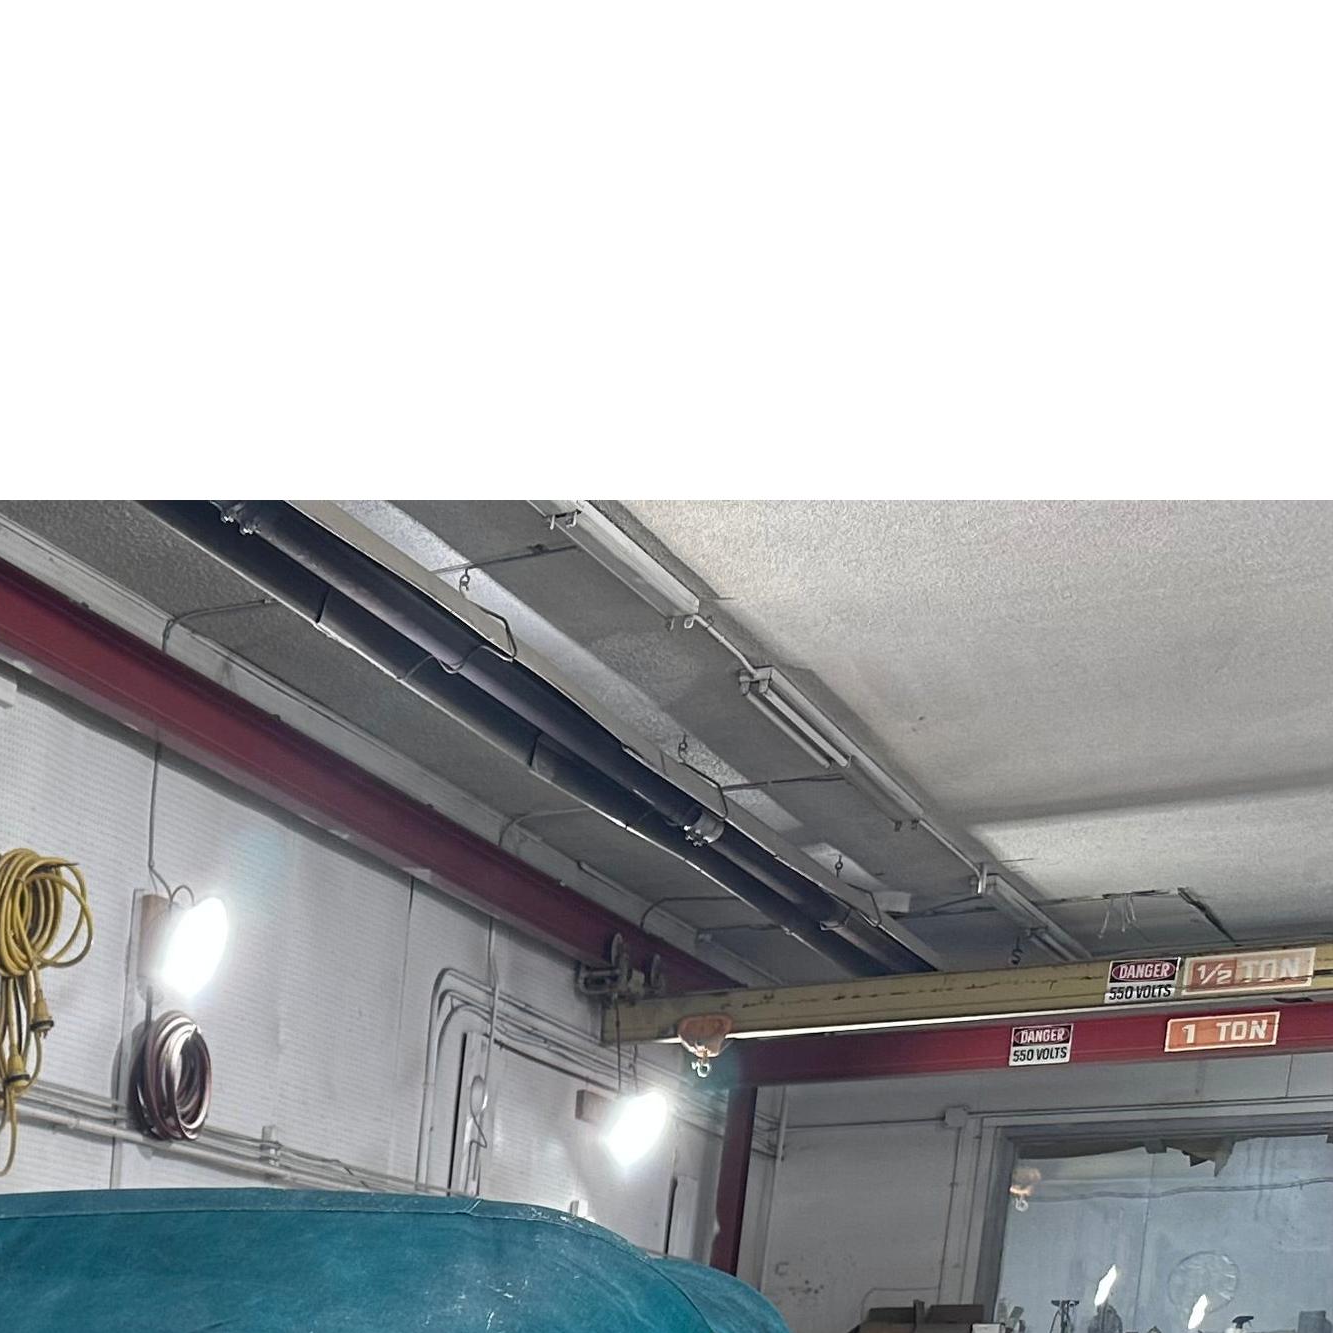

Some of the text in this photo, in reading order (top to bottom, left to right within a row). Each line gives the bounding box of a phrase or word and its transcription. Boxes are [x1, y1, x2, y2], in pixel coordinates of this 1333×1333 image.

[1118, 962, 1171, 980] DANGER
[1196, 956, 1300, 985] 1/2 TON
[1109, 984, 1172, 1001] 550 VOLTS
[1020, 1027, 1066, 1044] DANGER
[1182, 1019, 1268, 1044] 1 TON
[1012, 1046, 1068, 1063] 550 VOLTS
